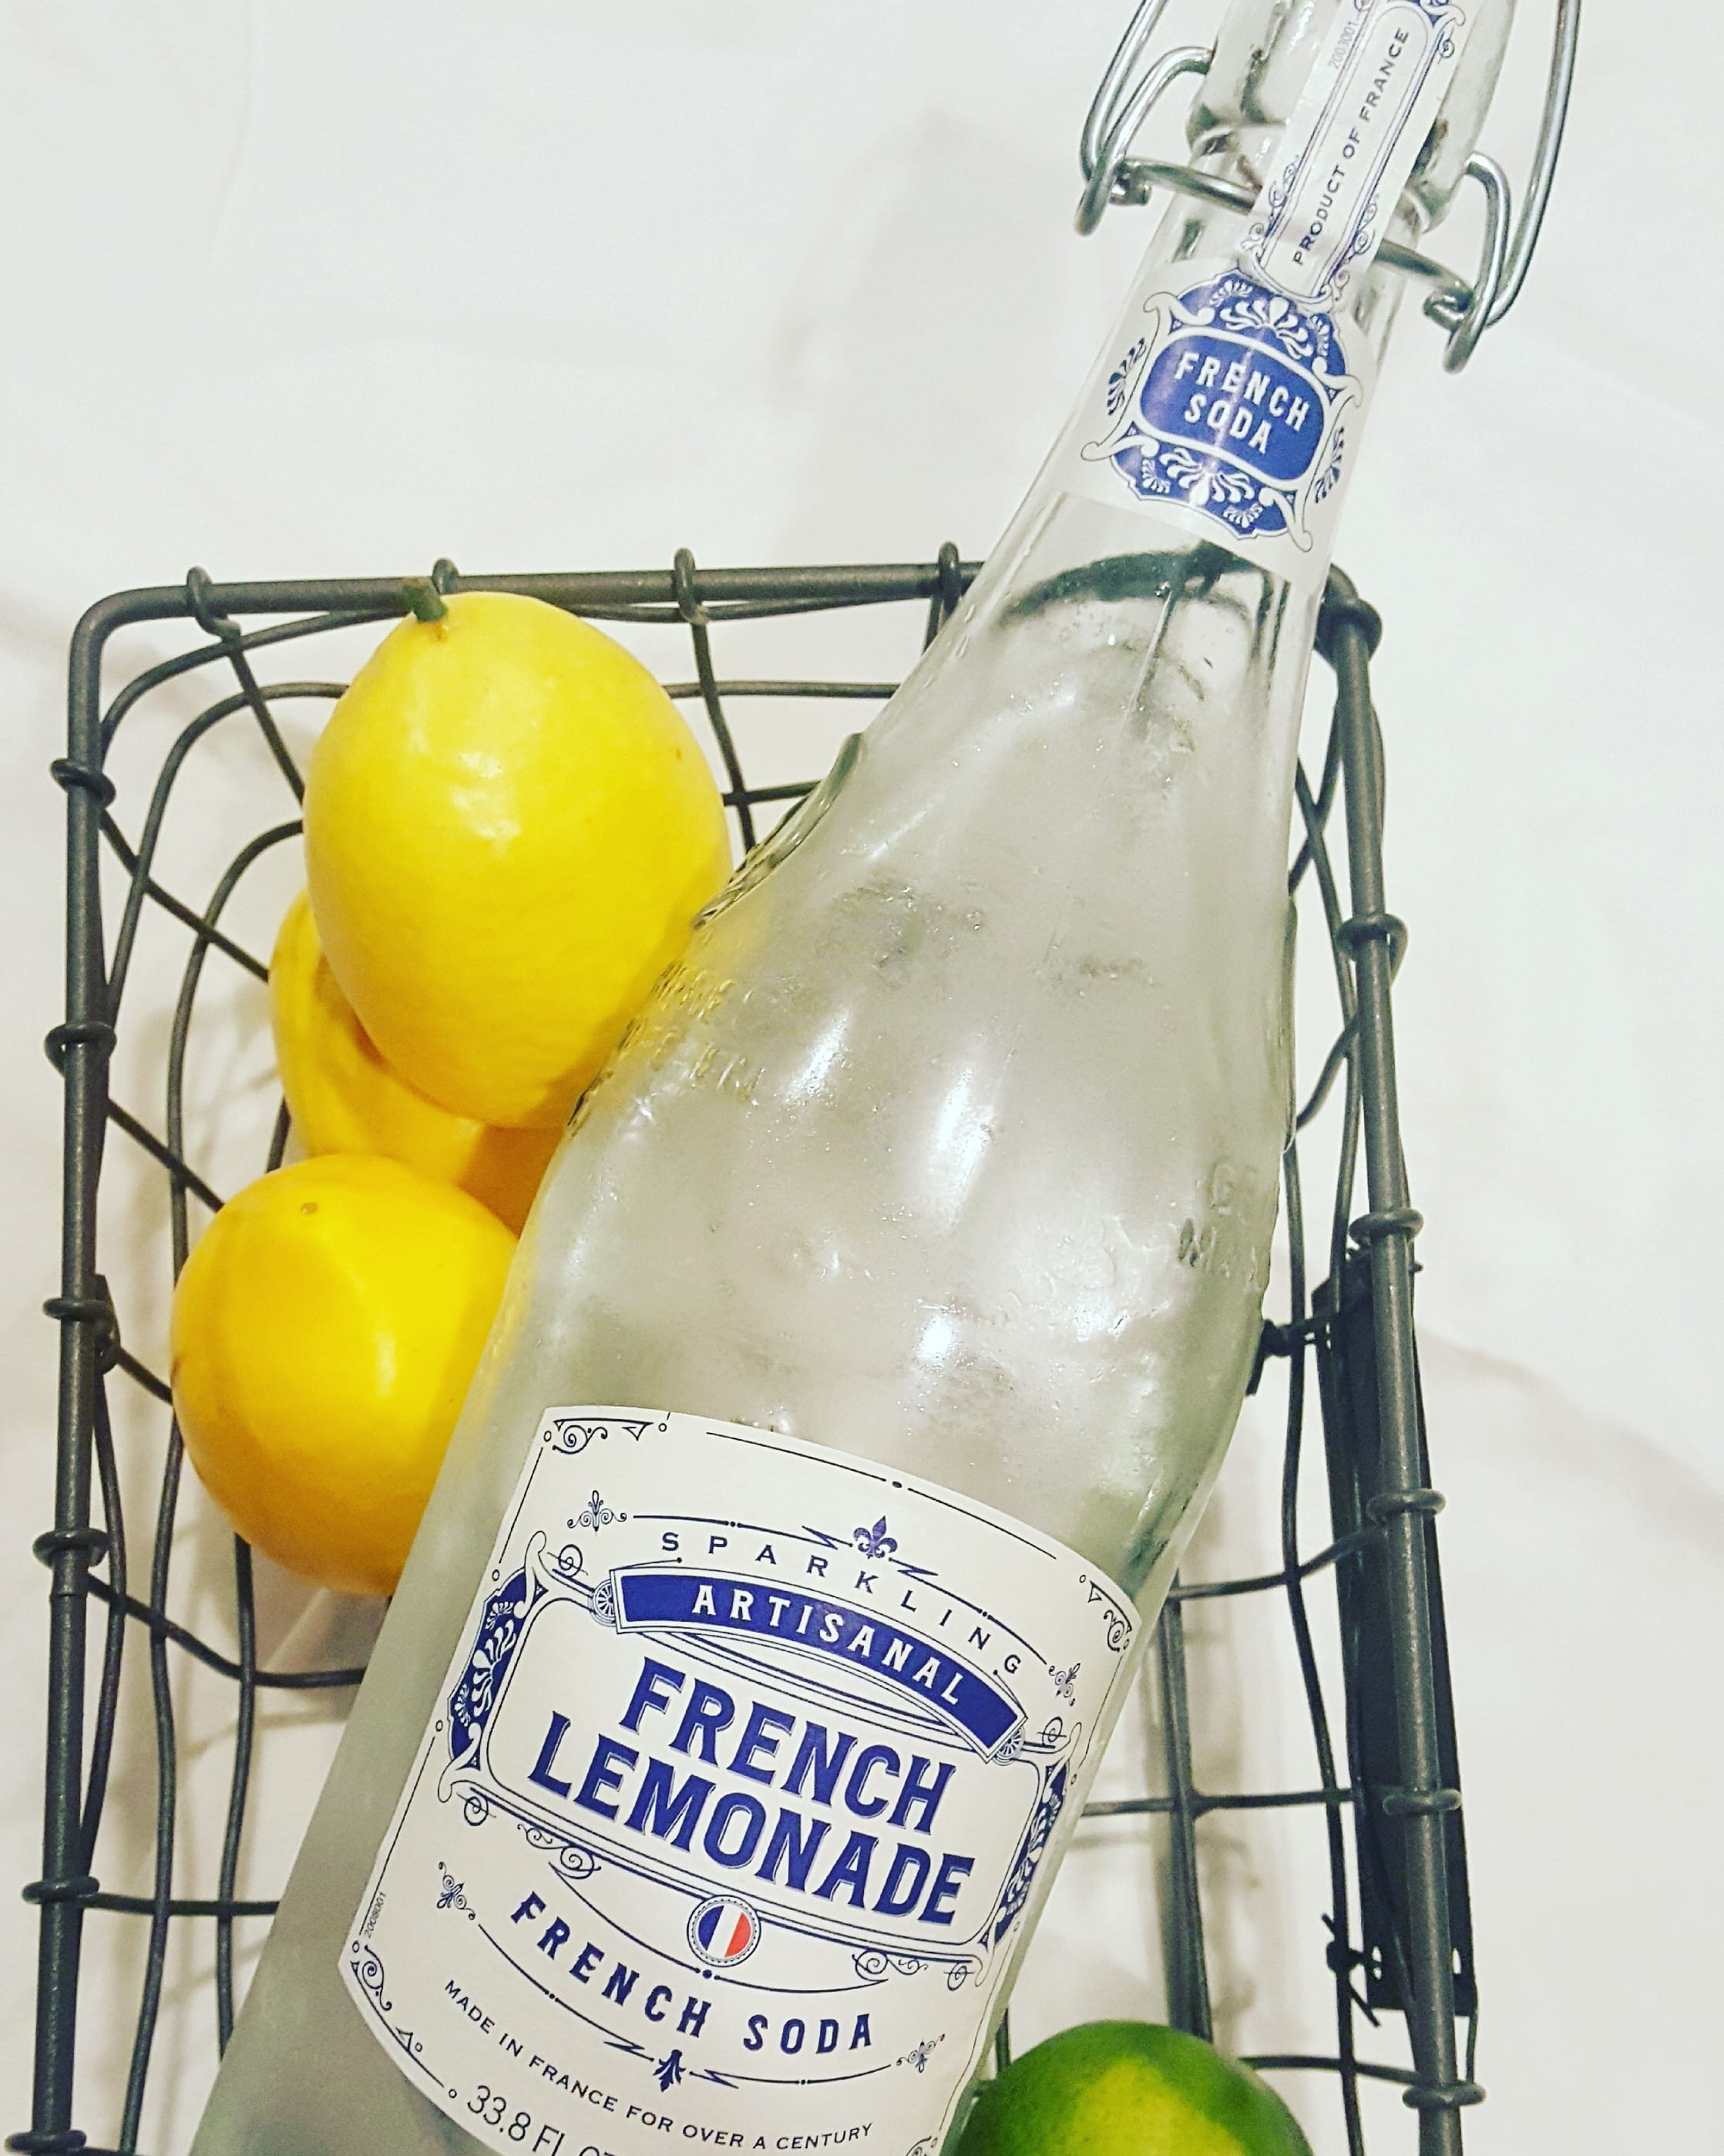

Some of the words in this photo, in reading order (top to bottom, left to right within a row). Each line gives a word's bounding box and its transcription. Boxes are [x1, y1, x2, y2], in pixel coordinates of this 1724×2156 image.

[1292, 164, 1345, 265] PRODUCT
[1342, 127, 1362, 160] OF
[1359, 27, 1410, 123] FRANCE
[1174, 351, 1310, 432] FRENCH
[1184, 392, 1272, 455] SODA
[661, 1532, 1021, 1674] SPARKLING
[691, 1584, 968, 1706] ARTISANAL
[526, 1710, 976, 1926] LEMONADE
[618, 1656, 956, 1835] FRENCH
[510, 1891, 712, 2038] FRENCH
[743, 2013, 872, 2055] SODA
[445, 1979, 496, 2034] MADE
[499, 2033, 523, 2057] IN
[529, 2055, 618, 2112] FRANCE
[626, 2104, 674, 2133] FOR
[682, 2124, 744, 2148] OVER
[753, 2136, 766, 2150] A
[776, 2121, 873, 2150] CENTURY
[467, 2084, 532, 2141] 33.8
